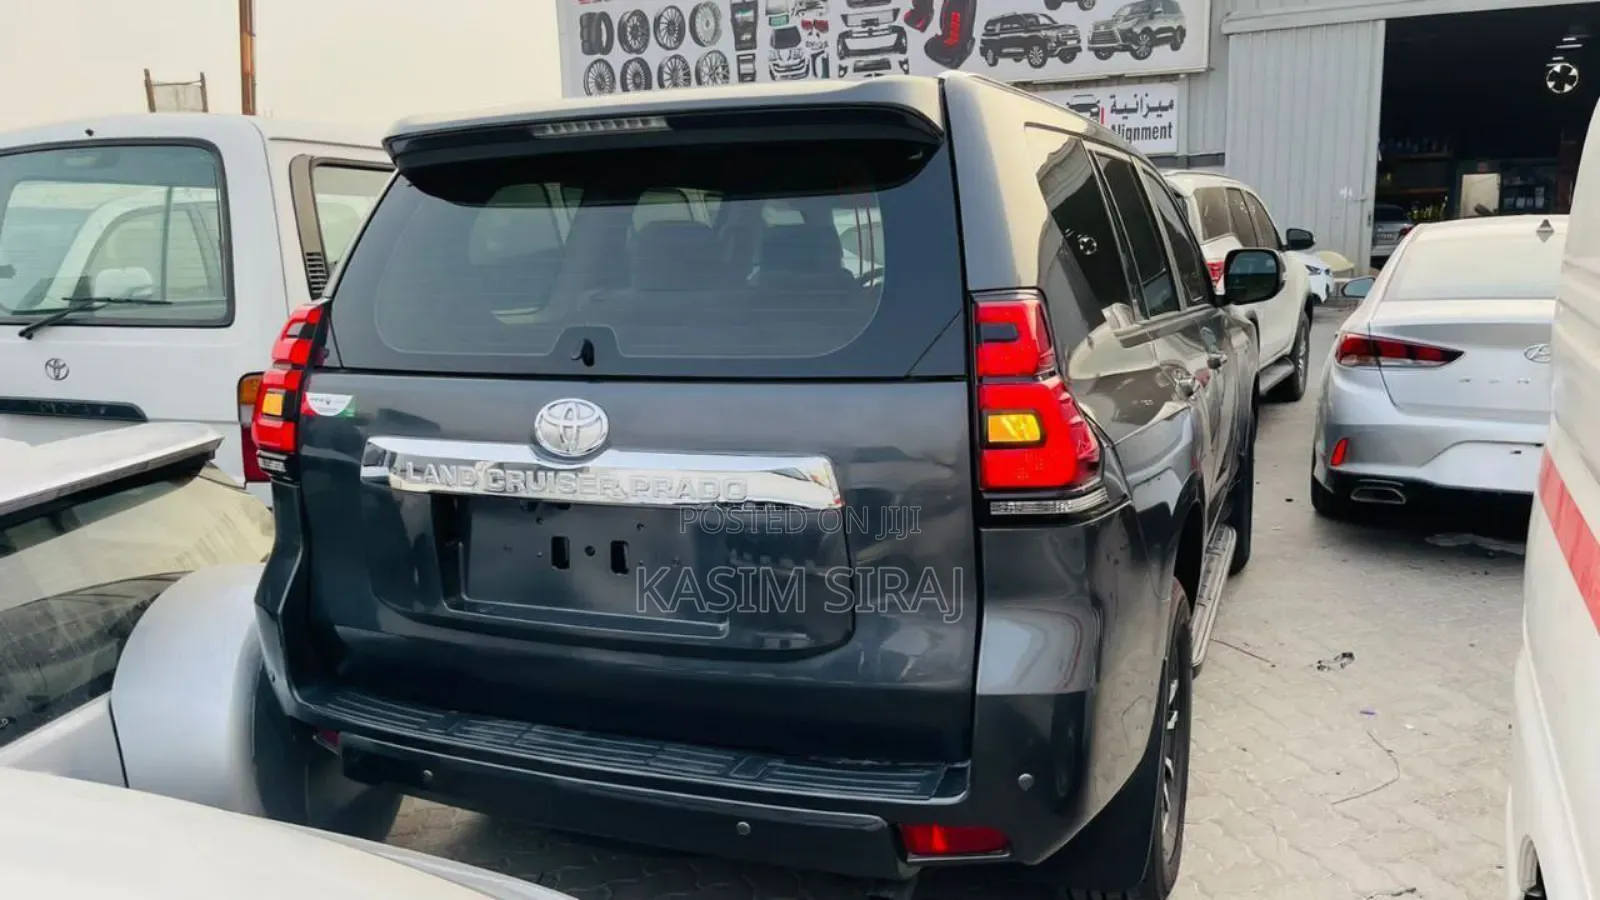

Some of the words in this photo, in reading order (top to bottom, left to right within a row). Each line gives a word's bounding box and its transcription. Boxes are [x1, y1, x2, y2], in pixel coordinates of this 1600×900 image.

[1109, 93, 1175, 120] ميزانية
[405, 461, 481, 489] LAND
[486, 467, 626, 499] CRUISER
[629, 475, 749, 502] PRADO
